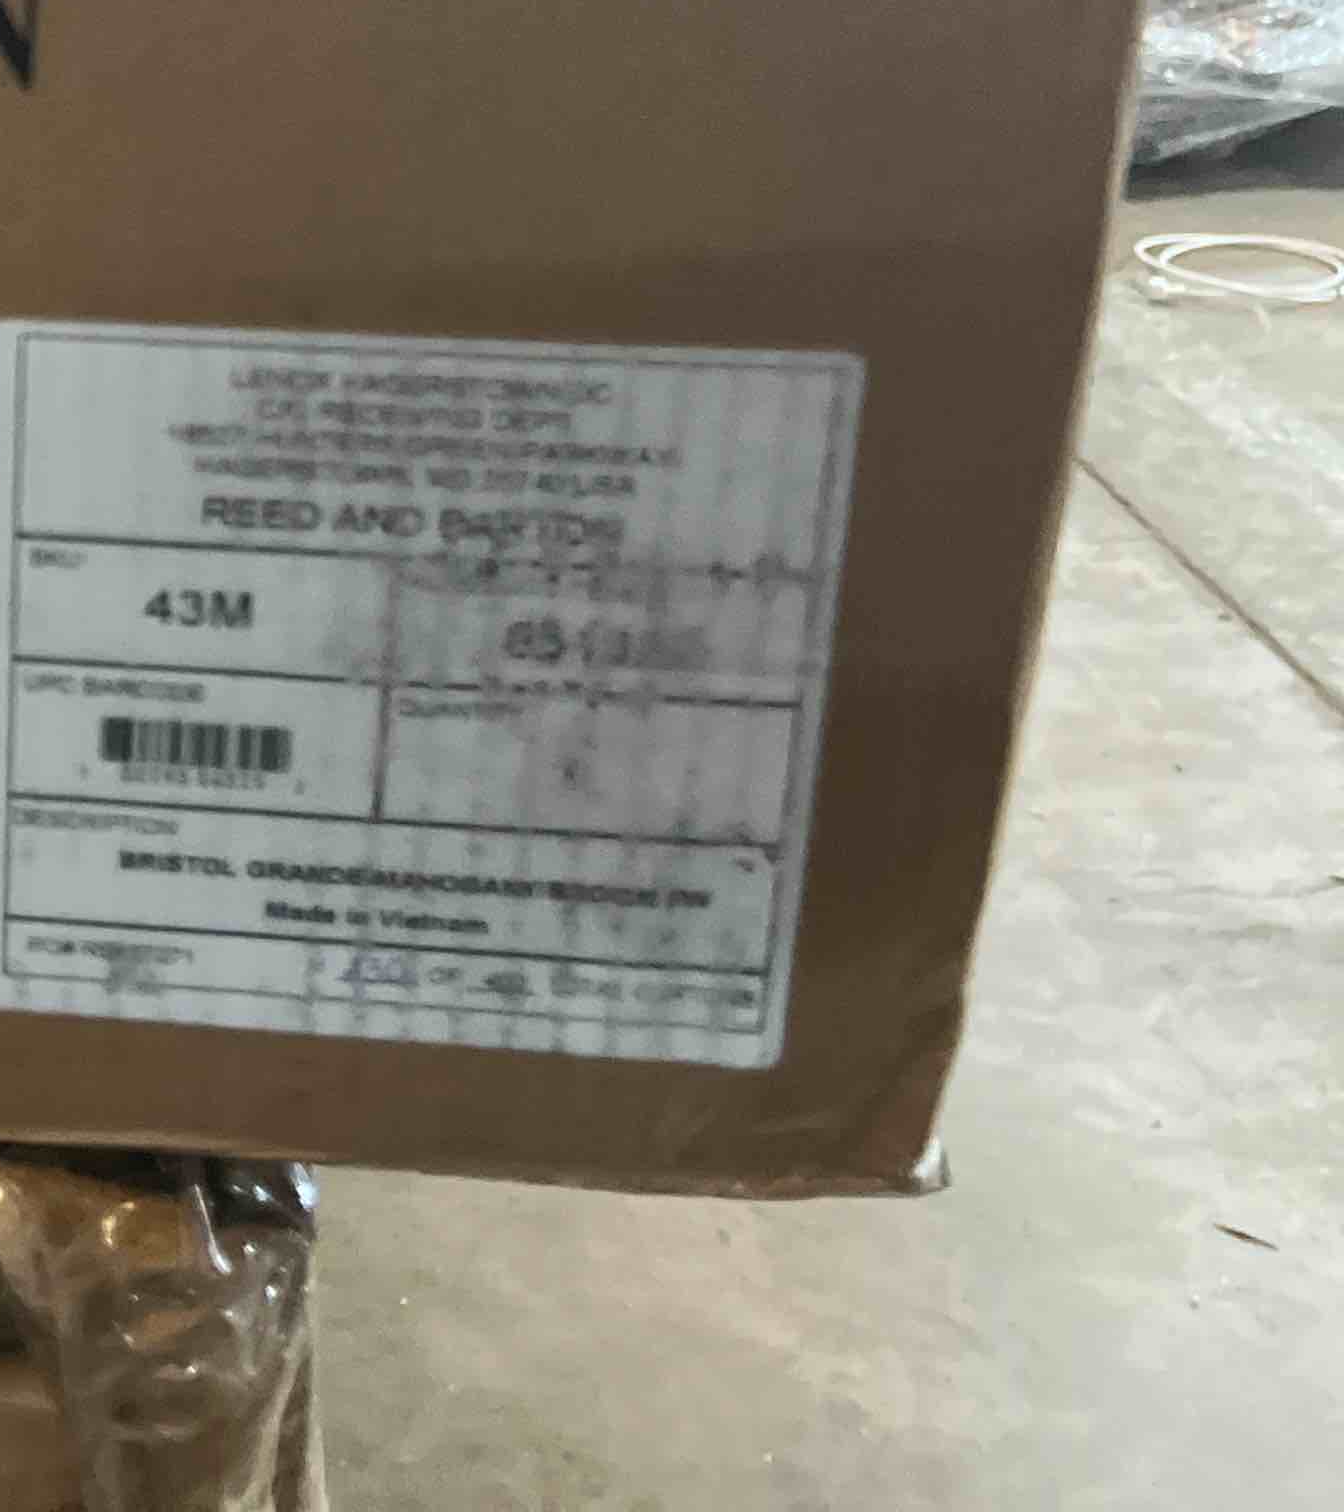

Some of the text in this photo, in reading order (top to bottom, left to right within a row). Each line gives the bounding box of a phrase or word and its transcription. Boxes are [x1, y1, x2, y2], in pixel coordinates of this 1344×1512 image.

[201, 495, 321, 530] REED
[332, 502, 426, 537] AND
[143, 588, 255, 630] 43M
[265, 899, 335, 926] Made
[380, 909, 489, 935] Vietnam
